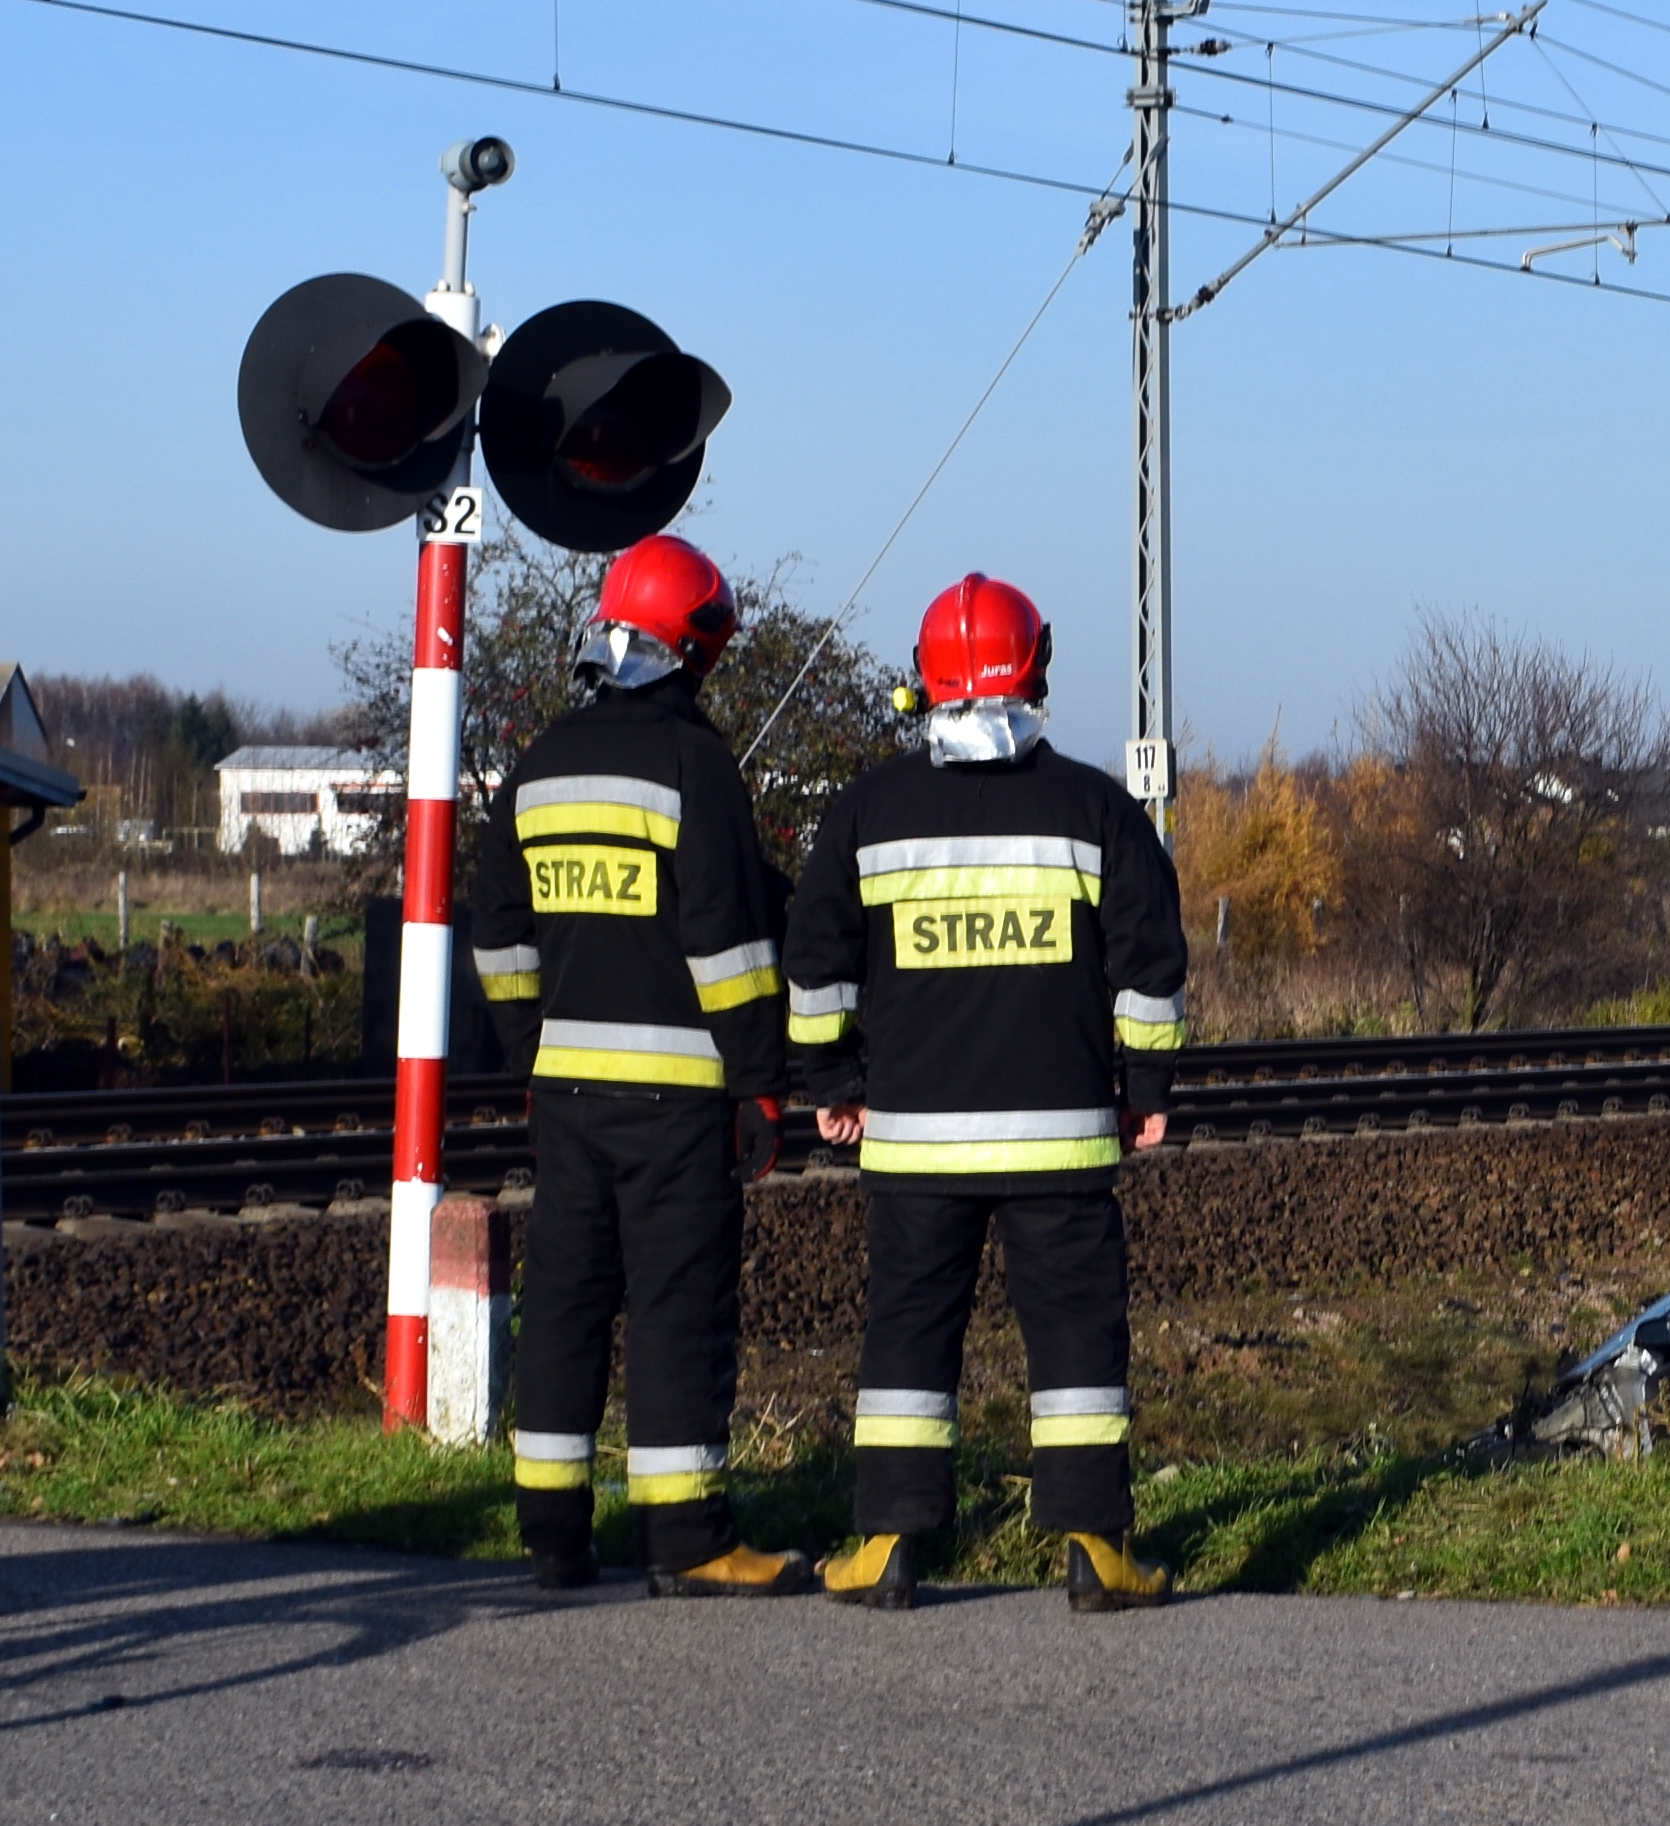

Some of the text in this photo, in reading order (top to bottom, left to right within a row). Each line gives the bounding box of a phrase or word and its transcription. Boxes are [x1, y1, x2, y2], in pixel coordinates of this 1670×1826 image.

[423, 493, 477, 534] S2
[1135, 745, 1156, 770] 117
[1143, 774, 1151, 792] 8
